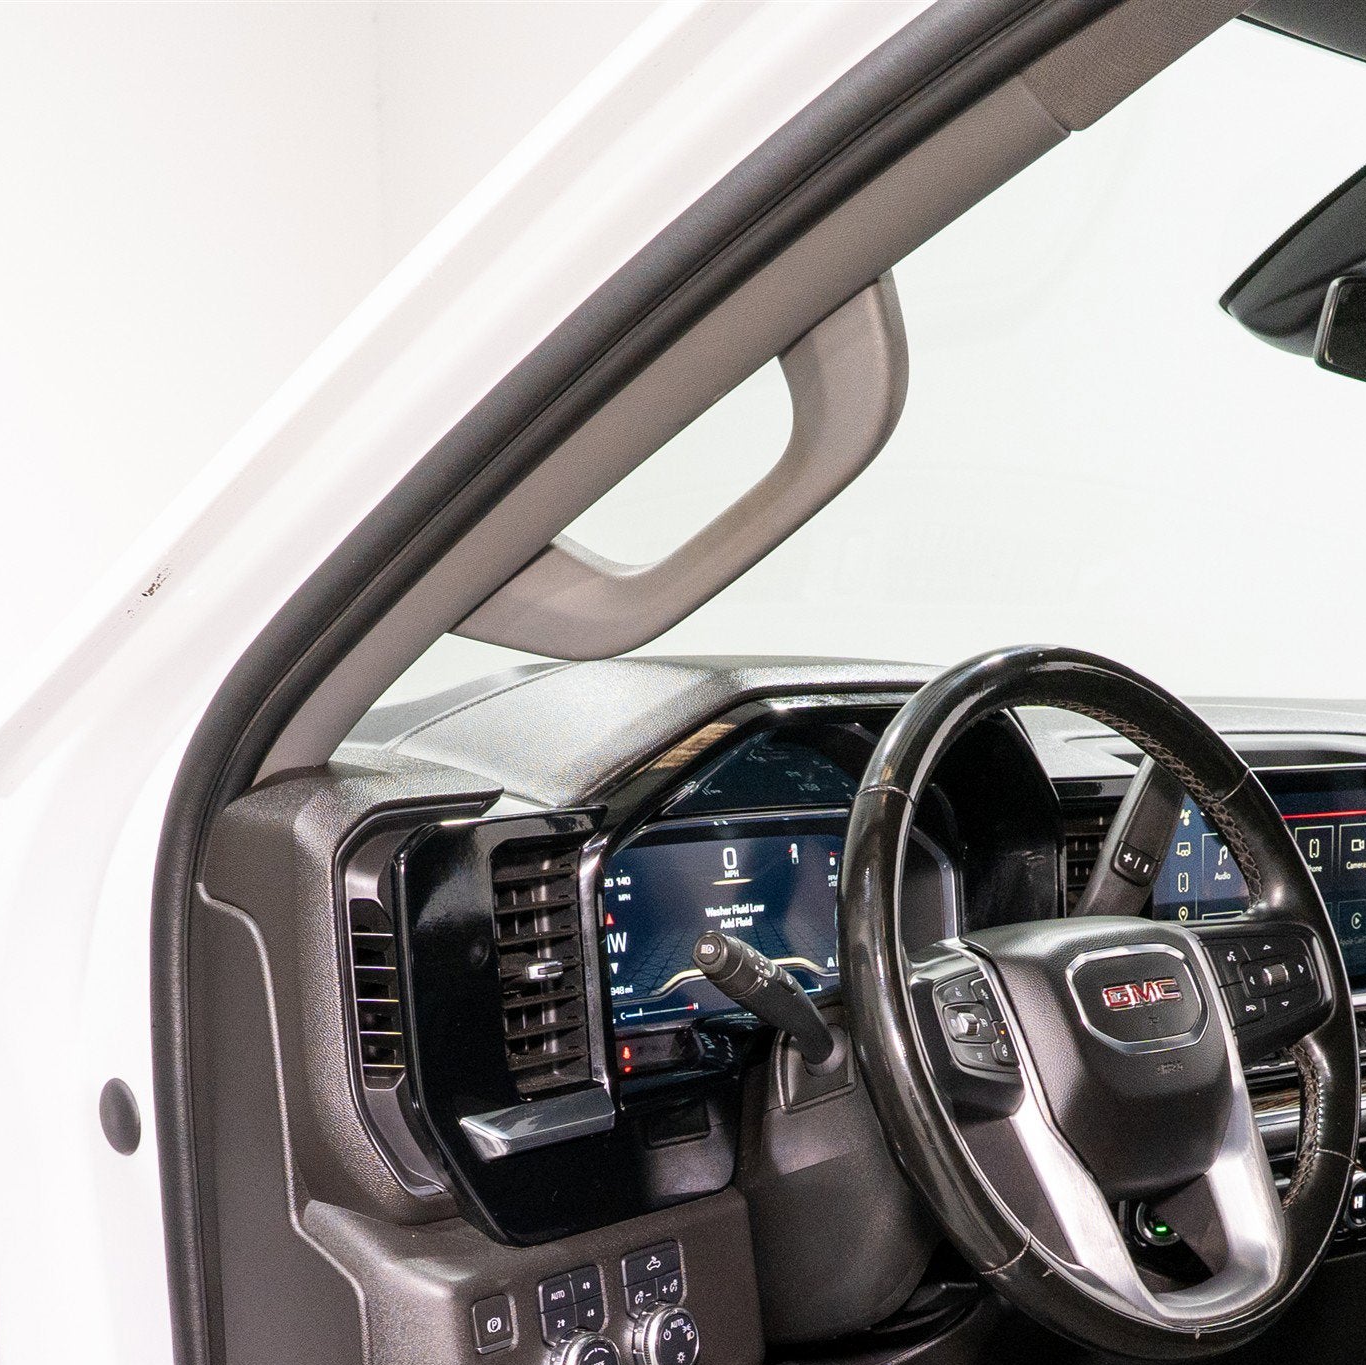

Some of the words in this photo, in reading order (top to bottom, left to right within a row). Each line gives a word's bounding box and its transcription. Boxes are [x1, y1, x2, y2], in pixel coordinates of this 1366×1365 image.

[723, 847, 737, 870] 0
[724, 870, 739, 878] MPH
[1307, 864, 1323, 873] hone
[616, 876, 631, 886] 140
[1215, 872, 1231, 880] Audio
[618, 893, 631, 901] MPH
[705, 906, 731, 917] Washer
[732, 903, 749, 914] Fluid
[750, 903, 765, 913] Low
[720, 918, 735, 929] Add
[735, 916, 753, 927] Fluid
[1102, 978, 1182, 1010] GMC
[551, 1290, 565, 1301] AUTO
[671, 1318, 684, 1329] AUTO
